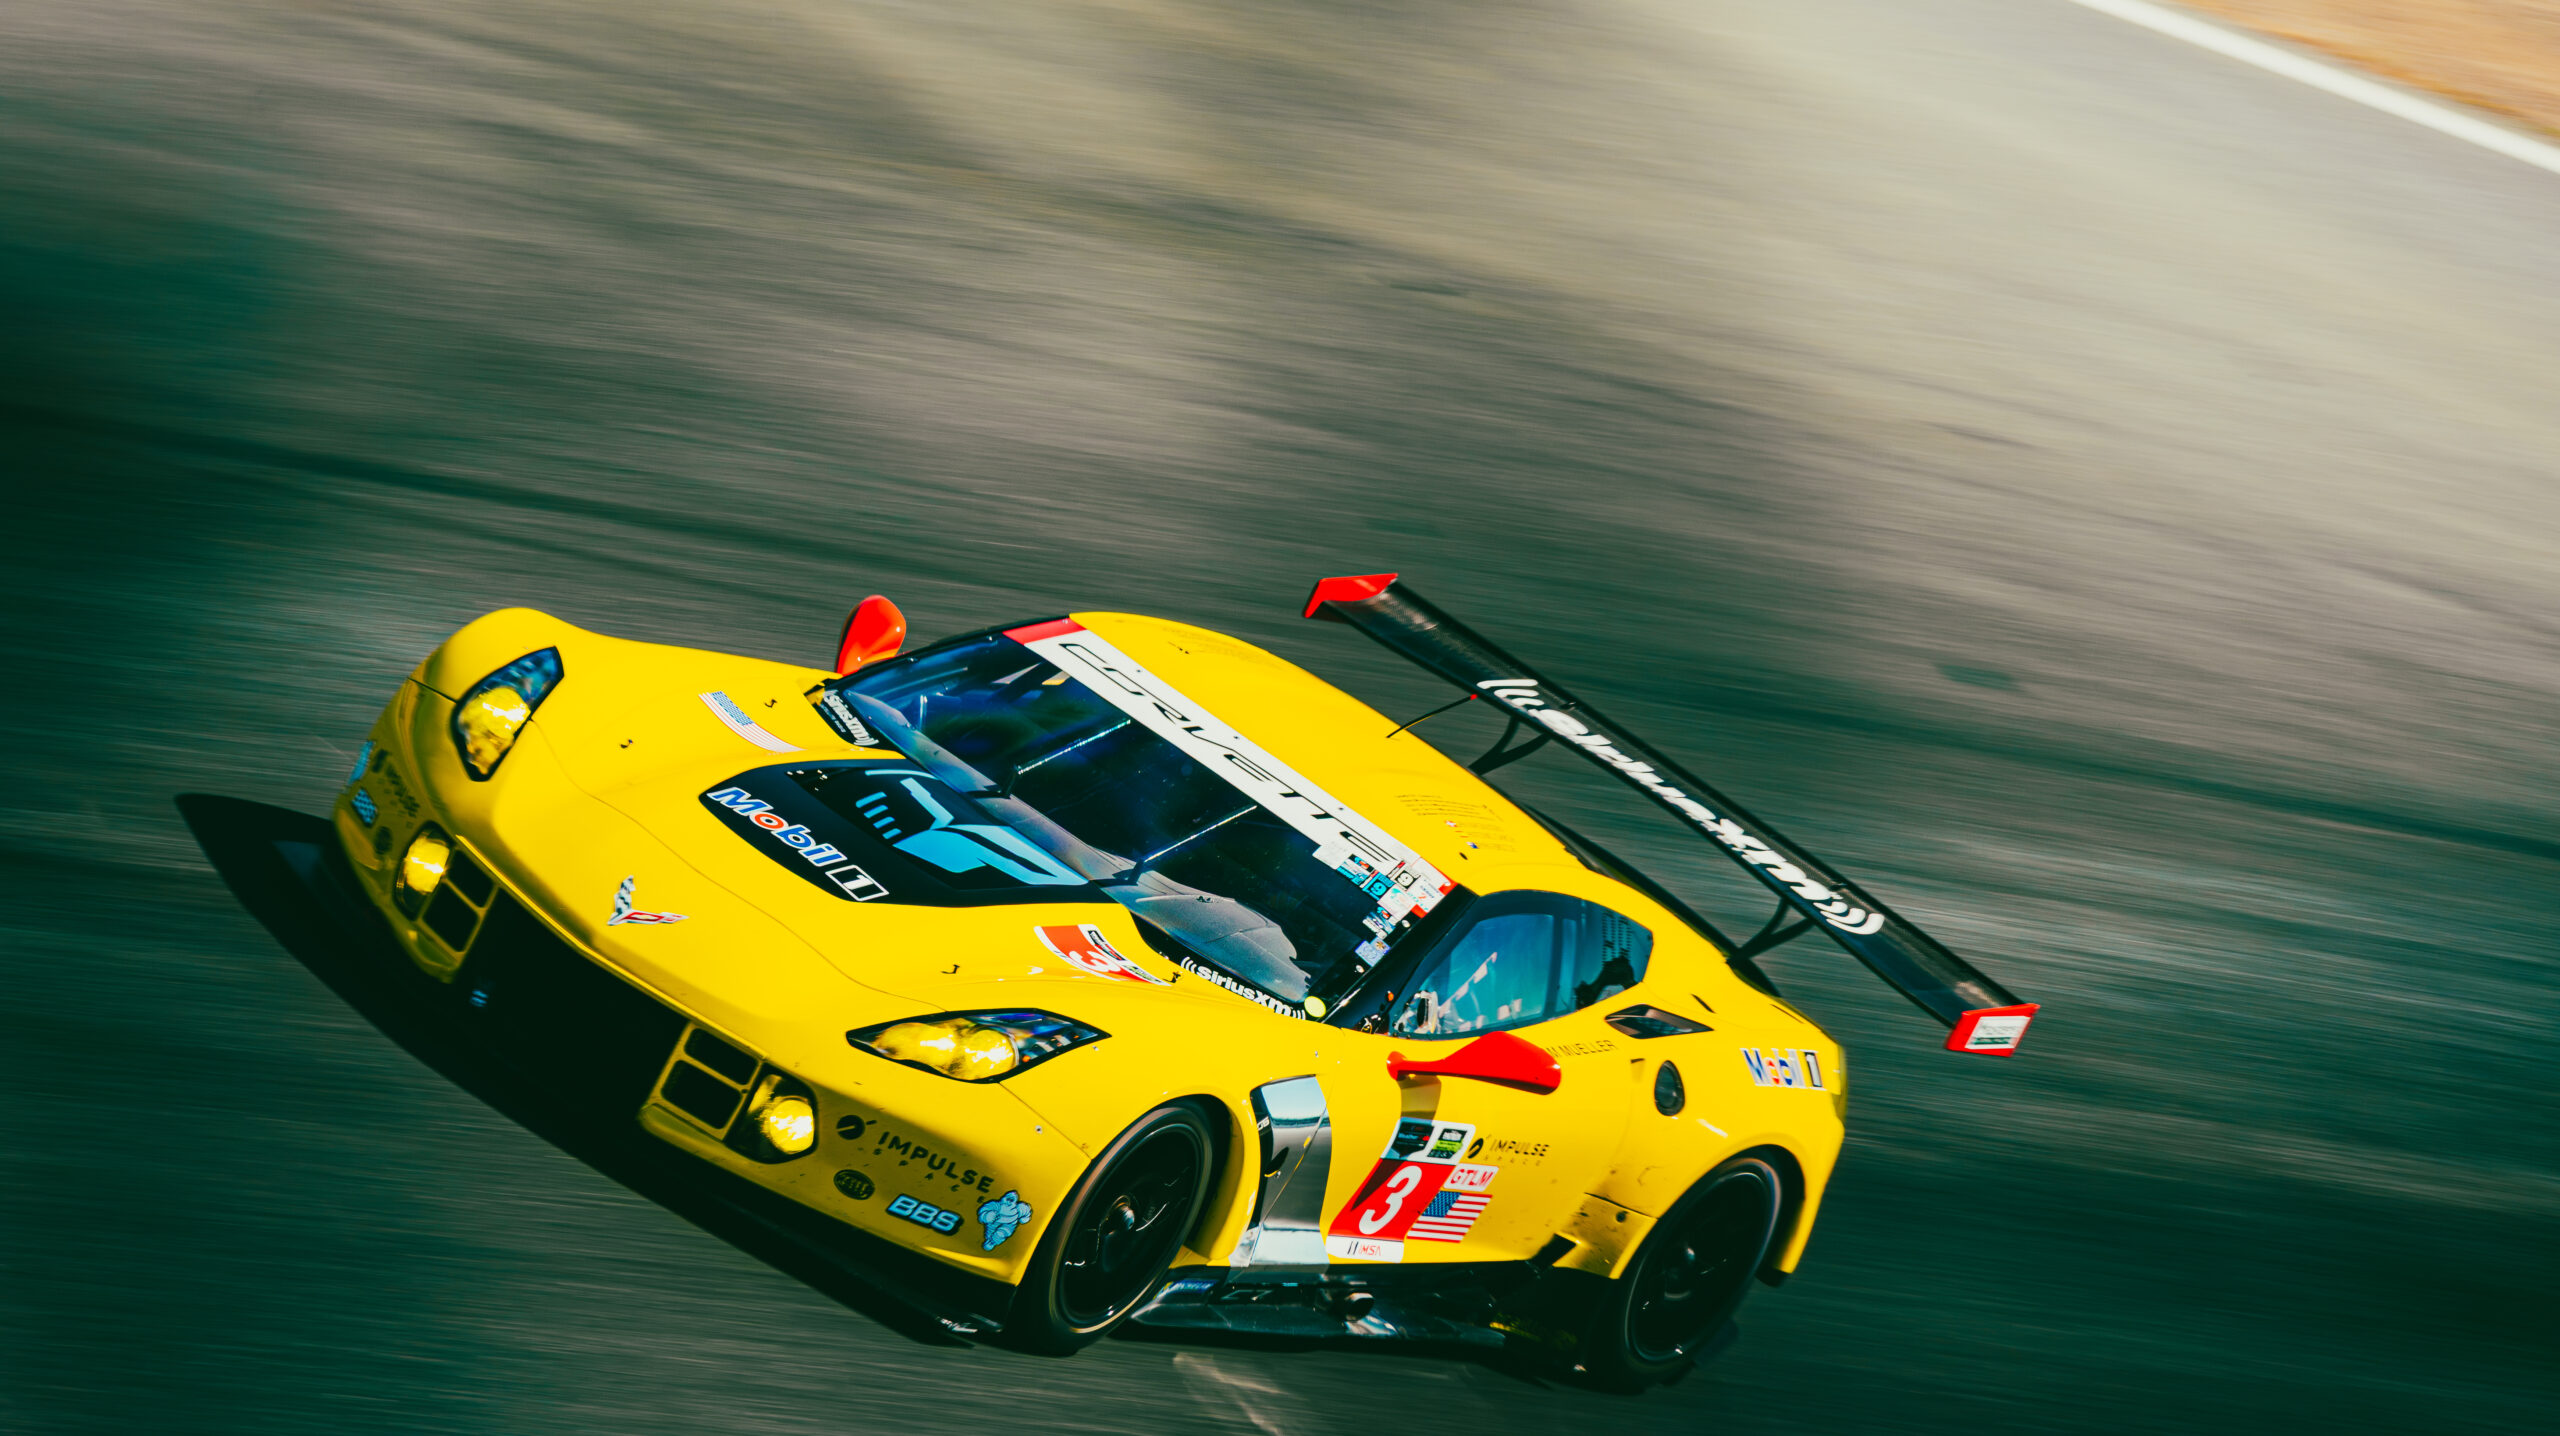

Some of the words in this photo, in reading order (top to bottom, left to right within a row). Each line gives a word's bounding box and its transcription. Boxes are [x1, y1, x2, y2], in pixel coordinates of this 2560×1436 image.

[706, 787, 847, 867] Mobil
[1068, 950, 1121, 973] 3
[1740, 1048, 1806, 1089] Mobil
[878, 1131, 994, 1193] IMPULSE
[1489, 1139, 1550, 1157] IMPULSE
[1450, 1168, 1493, 1186] GTLM
[887, 1194, 961, 1232] BBS
[1358, 1165, 1422, 1235] 3
[1357, 1244, 1382, 1256] IMSA
